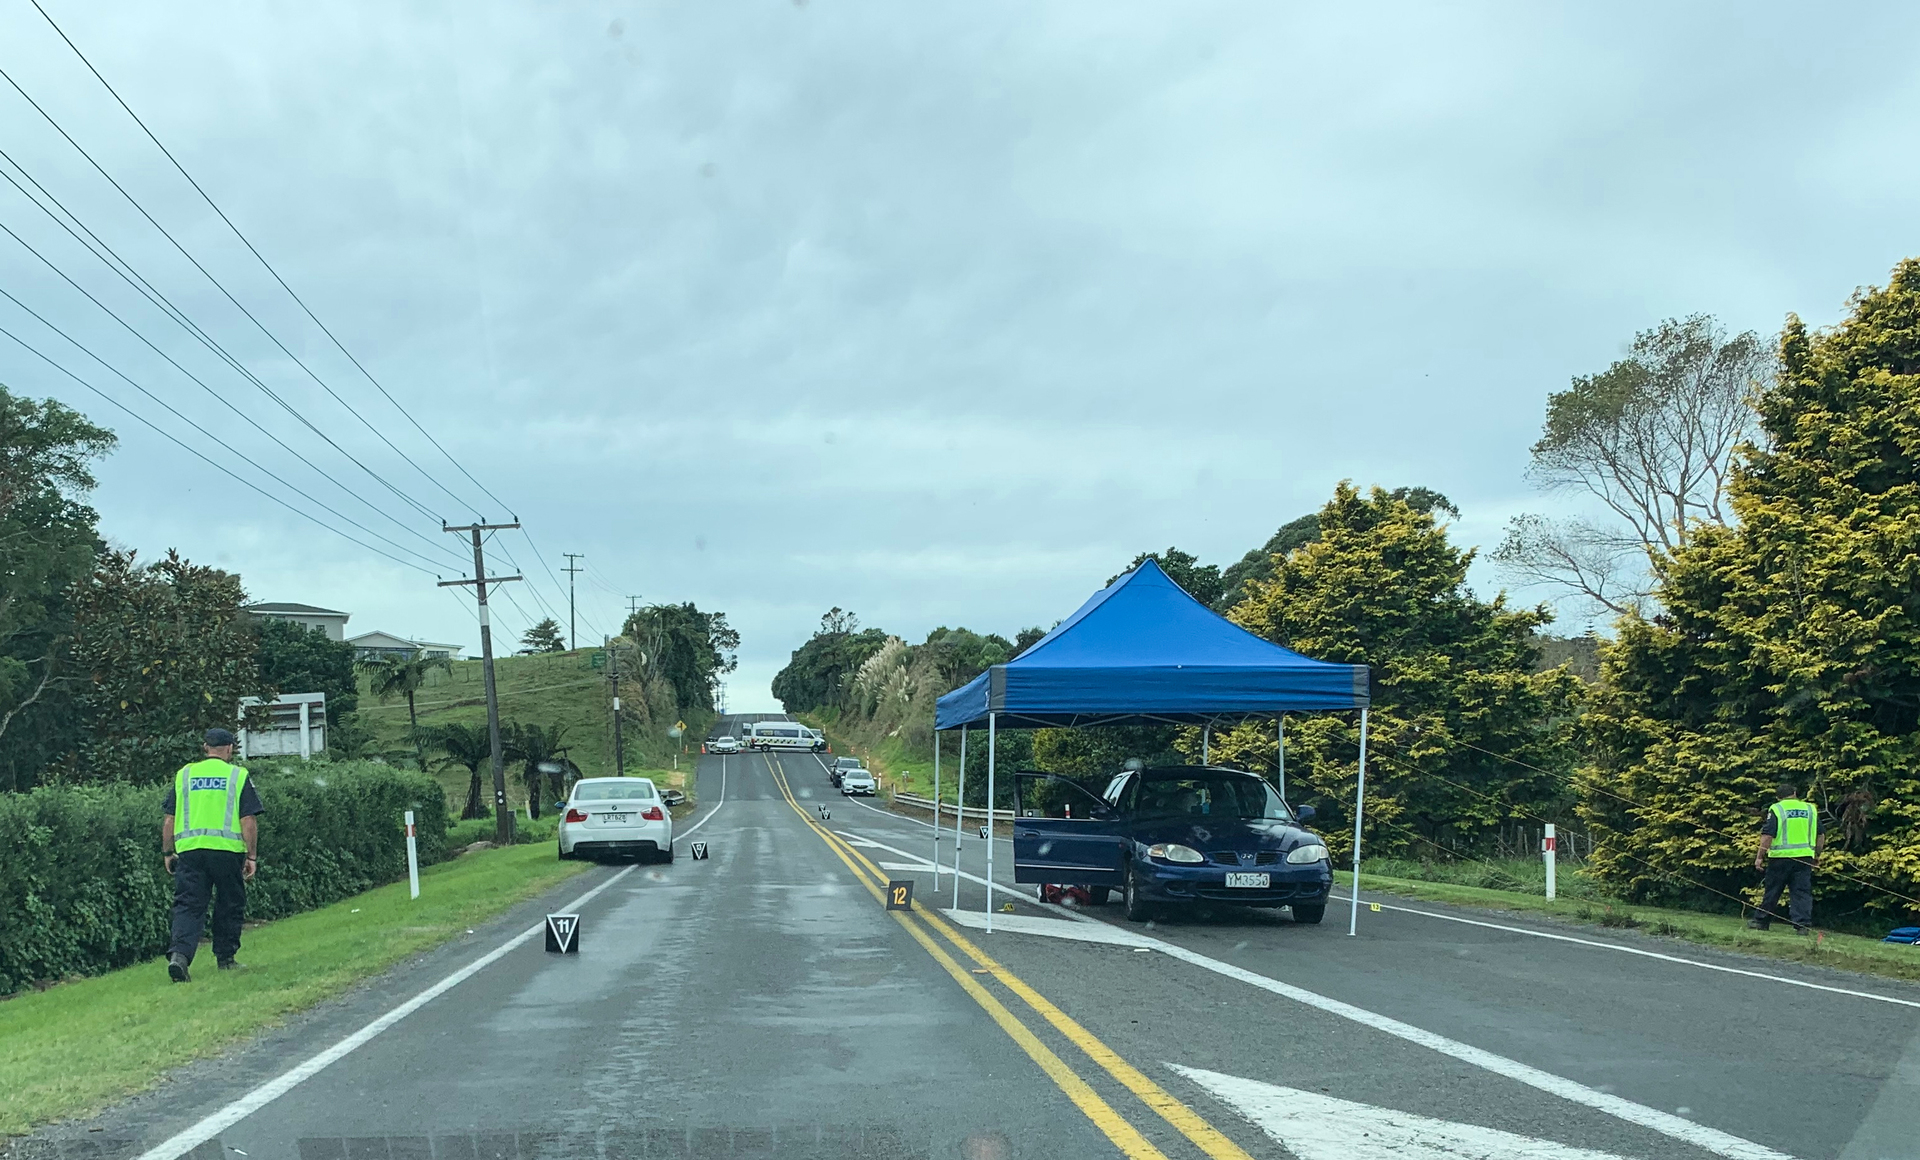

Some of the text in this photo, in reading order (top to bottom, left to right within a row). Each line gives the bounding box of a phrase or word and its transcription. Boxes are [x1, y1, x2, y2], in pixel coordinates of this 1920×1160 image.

[191, 778, 227, 789] POLICE
[893, 887, 907, 905] 12
[557, 919, 569, 933] 11
